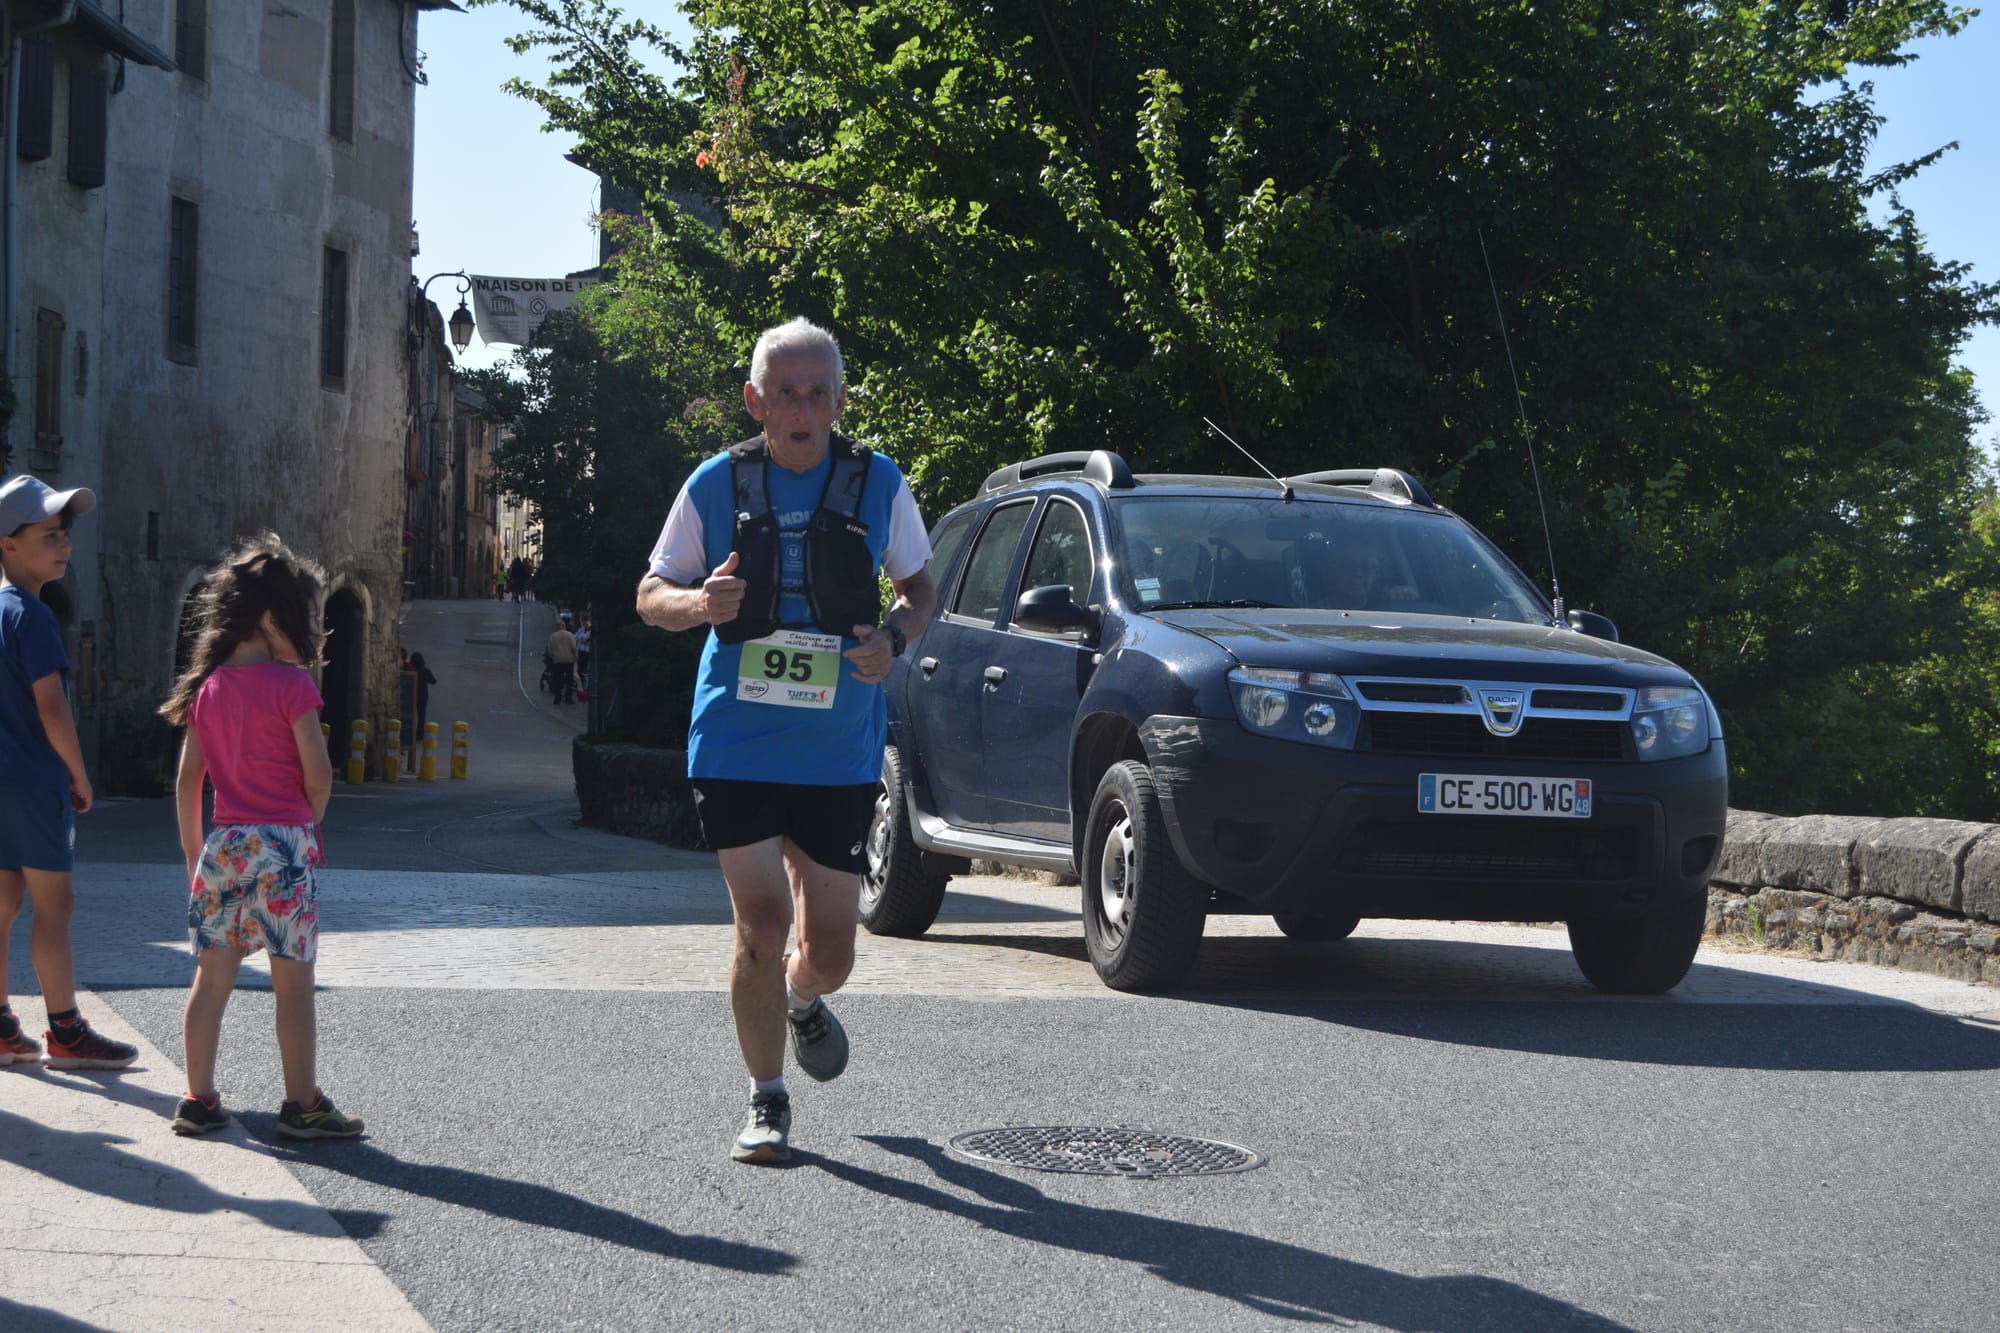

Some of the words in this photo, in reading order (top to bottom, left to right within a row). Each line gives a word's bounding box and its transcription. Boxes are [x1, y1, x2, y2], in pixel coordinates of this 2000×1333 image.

[476, 280, 546, 292] MAISON
[552, 281, 574, 292] DE
[763, 649, 813, 682] 95
[1424, 796, 1431, 805] F
[1440, 779, 1573, 813] CE-500-WG
[1575, 799, 1589, 814] 48
